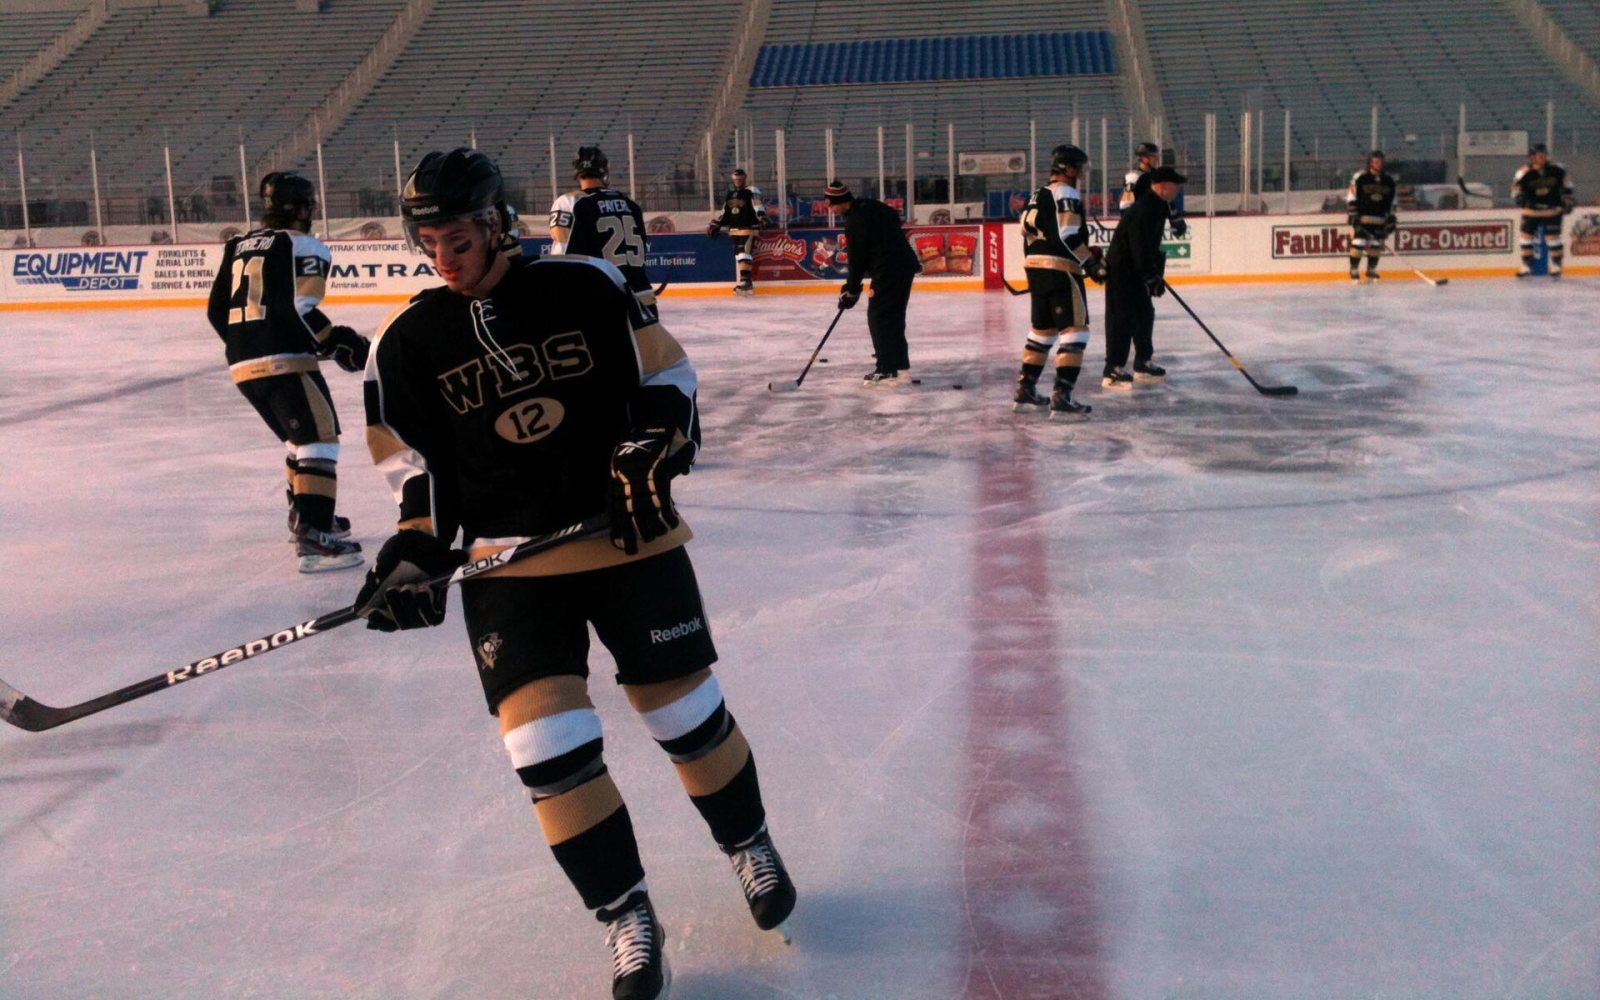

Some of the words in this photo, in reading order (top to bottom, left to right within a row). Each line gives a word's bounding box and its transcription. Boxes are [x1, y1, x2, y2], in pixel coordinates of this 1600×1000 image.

[551, 212, 570, 226] 25
[596, 215, 645, 267] 25
[1398, 228, 1507, 249] Pre-Owned
[158, 250, 199, 258] FORKLIFTS
[200, 249, 207, 257] &
[356, 243, 399, 251] KEYSTONE
[989, 231, 998, 273] CCM
[13, 251, 149, 280] EQUIPMENT
[156, 259, 182, 267] AERIAL
[184, 258, 205, 266] LIFTS
[659, 256, 697, 266] Institute
[154, 270, 178, 278] SALES
[179, 270, 185, 278] &
[330, 263, 435, 277] MTRA
[79, 277, 126, 290] DEPOT
[151, 281, 183, 289] SERVICE
[193, 280, 213, 288] PART
[331, 280, 378, 289] Amtrak.com
[437, 330, 594, 415] WBS
[509, 403, 550, 440] 12
[650, 617, 703, 644] Reebok
